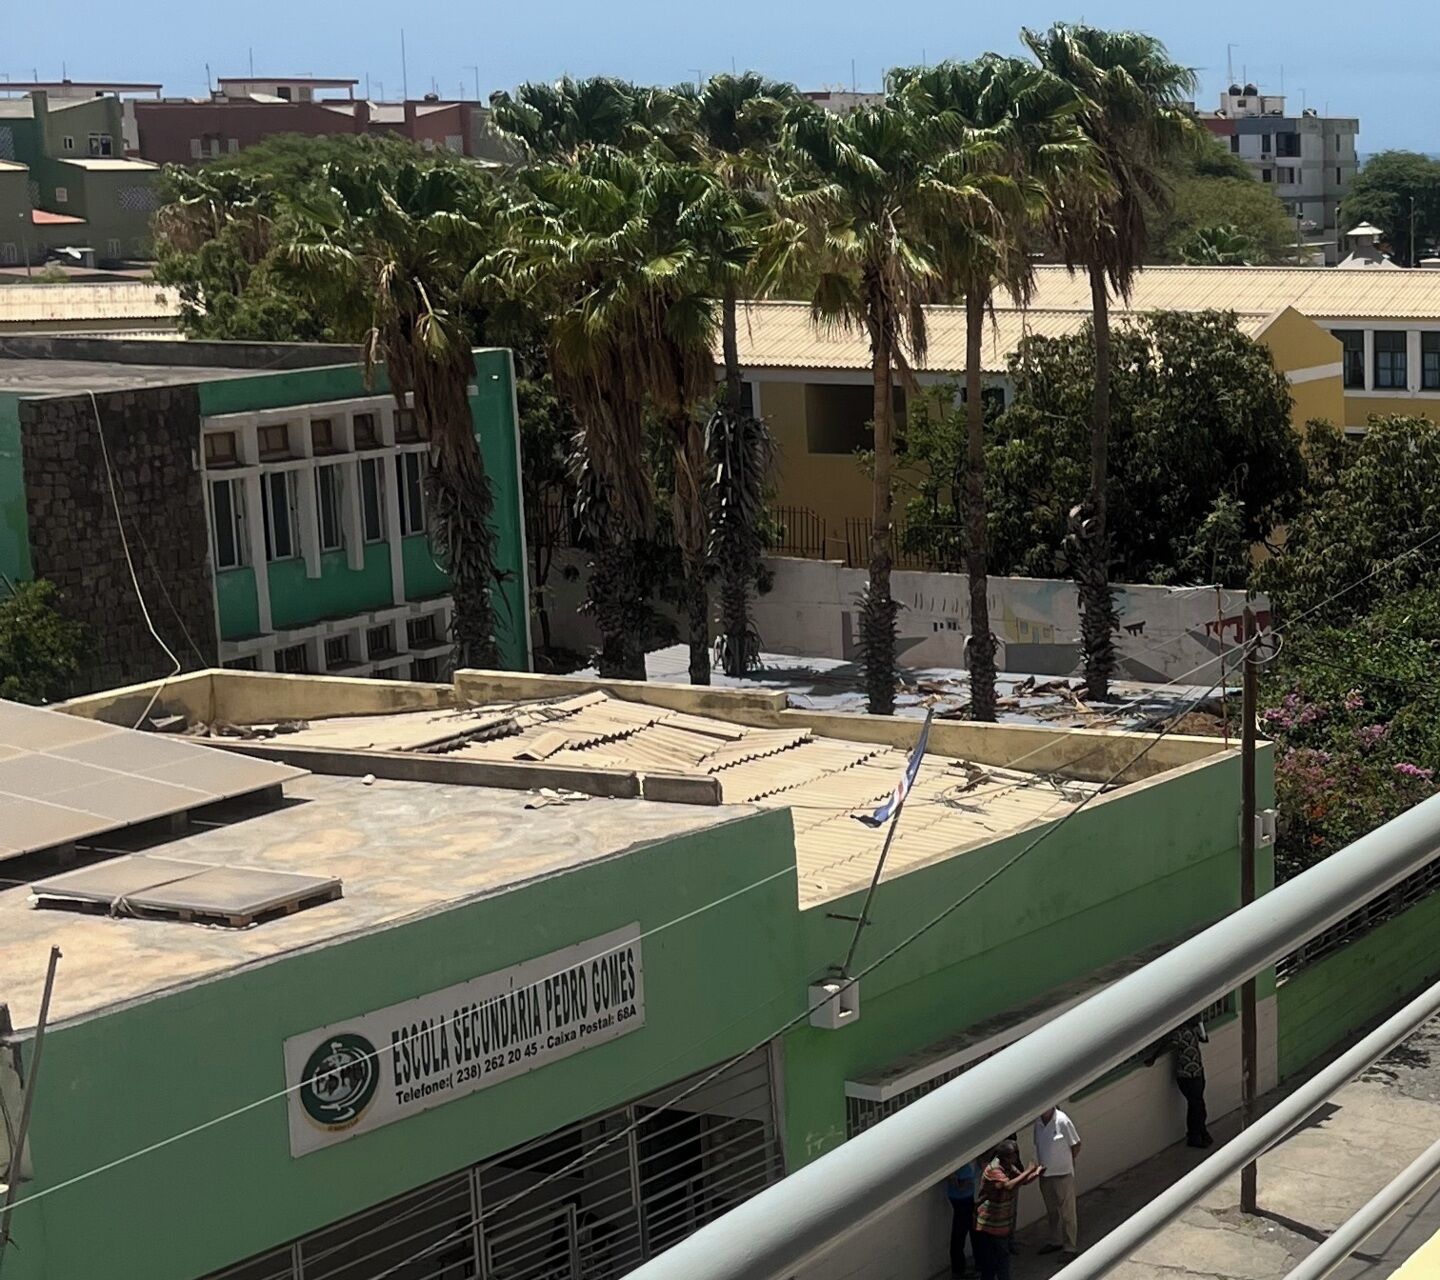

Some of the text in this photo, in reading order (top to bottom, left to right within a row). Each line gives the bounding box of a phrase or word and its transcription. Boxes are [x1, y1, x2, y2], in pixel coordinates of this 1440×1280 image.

[392, 1014, 450, 1087] ESCOLA
[453, 976, 542, 1065] SECUNDÁRIA
[544, 964, 587, 1031] PEDRO
[592, 947, 635, 1014] GOMES
[484, 1054, 505, 1073] 262
[508, 1048, 521, 1064] 20
[524, 1042, 538, 1057] 45
[546, 1030, 577, 1049] Caixa
[579, 1013, 615, 1037] Postal:
[617, 1004, 637, 1022] 68A
